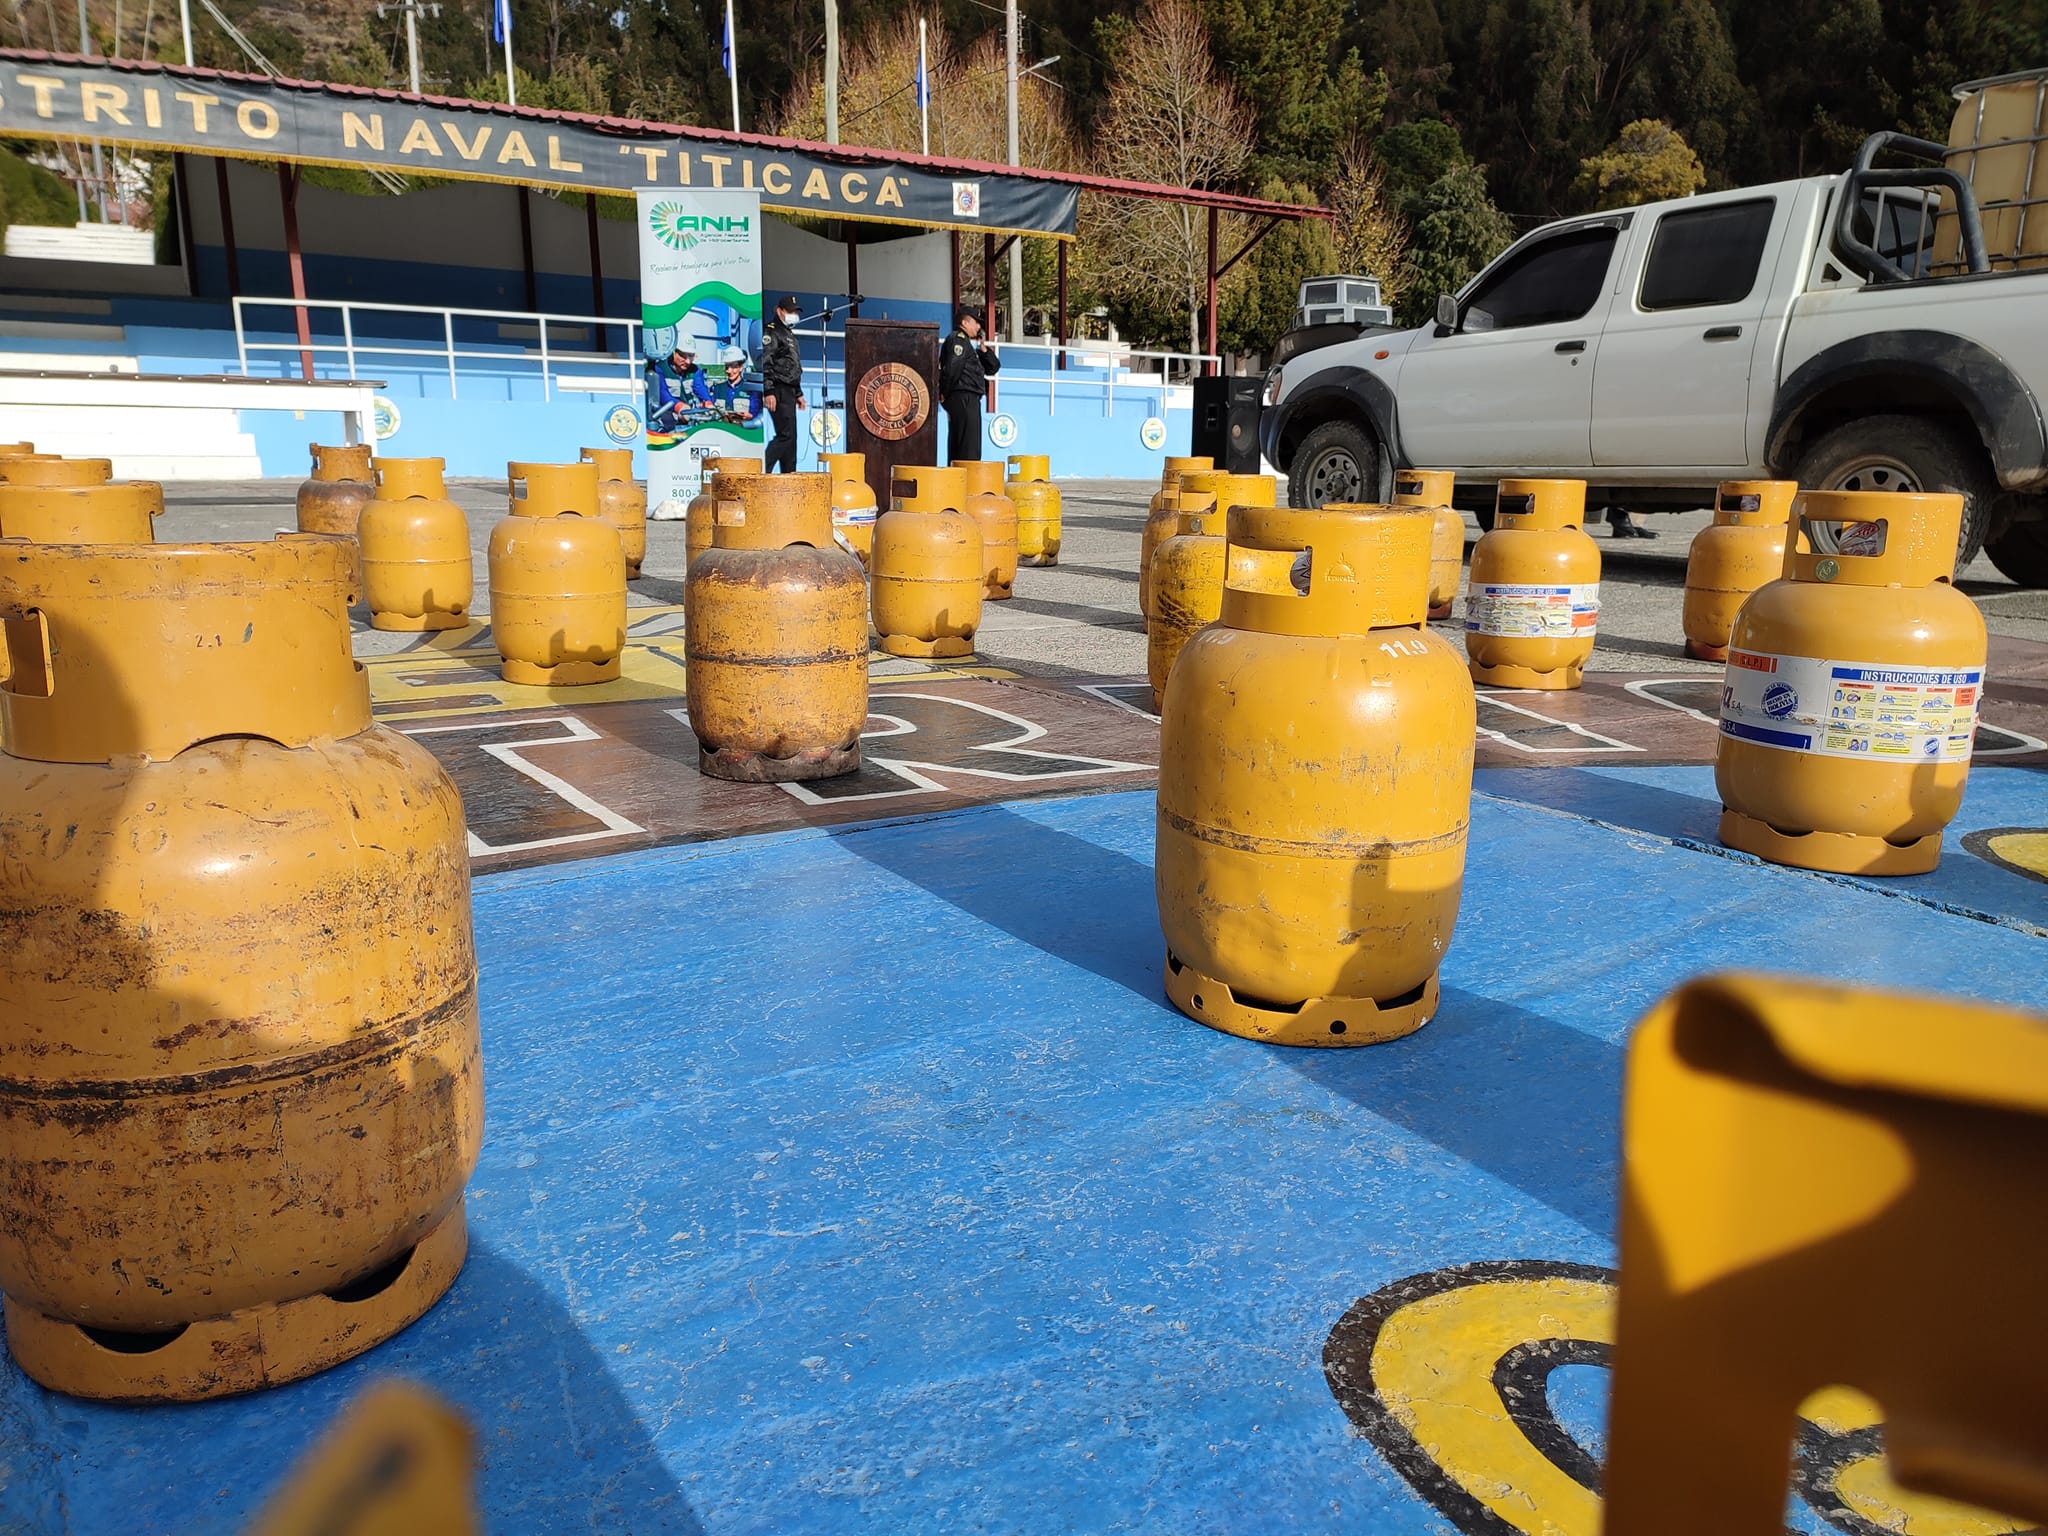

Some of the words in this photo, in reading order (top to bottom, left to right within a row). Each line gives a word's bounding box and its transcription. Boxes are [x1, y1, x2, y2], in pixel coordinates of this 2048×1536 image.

[0, 74, 280, 140] TRITO
[342, 111, 583, 173] NAVAL
[677, 216, 749, 231] ANH
[1379, 639, 1430, 659] 11.9
[1860, 670, 1940, 685] INSTRUCCIONES
[1941, 673, 1954, 684] DE
[1953, 673, 1967, 684] USO
